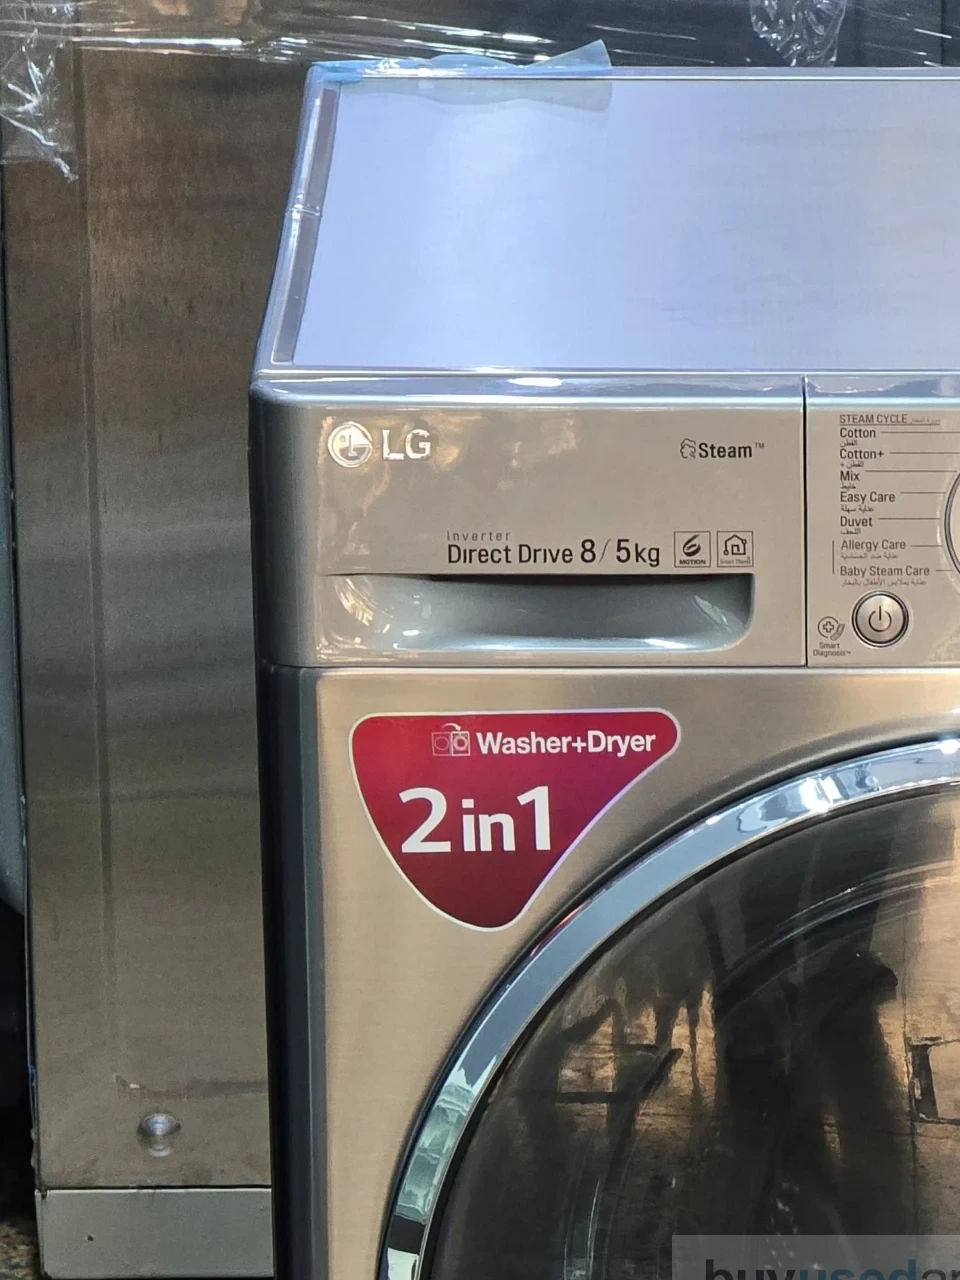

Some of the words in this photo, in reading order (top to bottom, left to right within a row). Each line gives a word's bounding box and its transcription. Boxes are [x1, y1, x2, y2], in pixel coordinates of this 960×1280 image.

[840, 414, 874, 424] STEAM
[876, 414, 908, 424] CYCLE
[840, 427, 876, 438] Cotton
[382, 429, 431, 460] LG
[840, 448, 884, 459] Cotton+
[840, 470, 860, 481] Mix
[840, 491, 867, 504] Easy
[869, 491, 896, 502] Care
[840, 516, 873, 527] Duvet
[446, 530, 511, 542] Inverter
[841, 540, 878, 552] Allergy
[881, 539, 907, 550] Care
[447, 543, 512, 564] Direct
[518, 543, 573, 564] Drive
[840, 565, 866, 578] Baby
[869, 565, 903, 576] Steam
[905, 565, 930, 576] Care
[476, 729, 656, 757] Washer+Dryer
[399, 787, 451, 853] 2
[462, 798, 516, 852] in
[517, 785, 551, 851] 1
